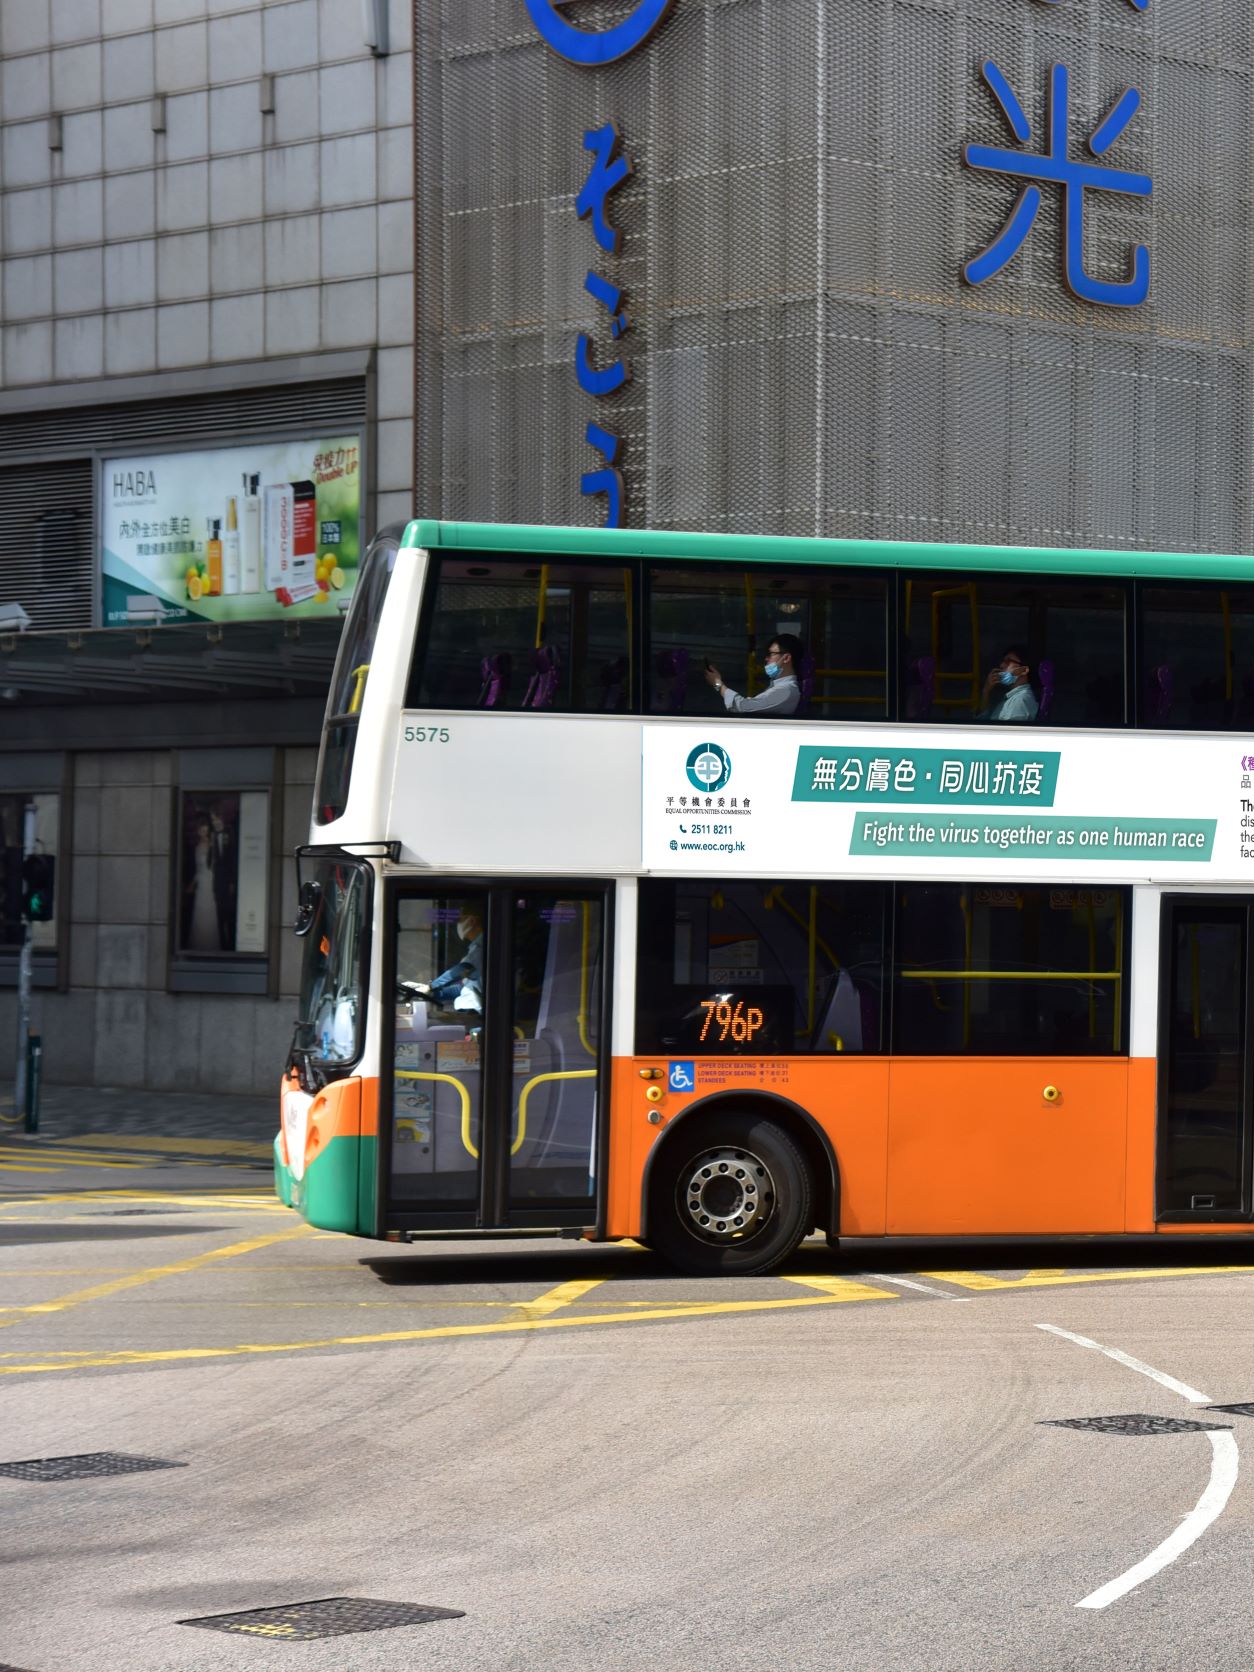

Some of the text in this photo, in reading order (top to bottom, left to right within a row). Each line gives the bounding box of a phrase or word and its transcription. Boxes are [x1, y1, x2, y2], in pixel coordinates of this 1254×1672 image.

[113, 470, 157, 498] HABA
[403, 727, 451, 743] 5575
[666, 796, 751, 808] 平等機會委員會
[691, 824, 732, 834] 2511 8211
[863, 821, 1205, 849] Fight the virus together as one human race
[681, 841, 745, 853] www.eoc.org.hk
[699, 1001, 764, 1041] 796P
